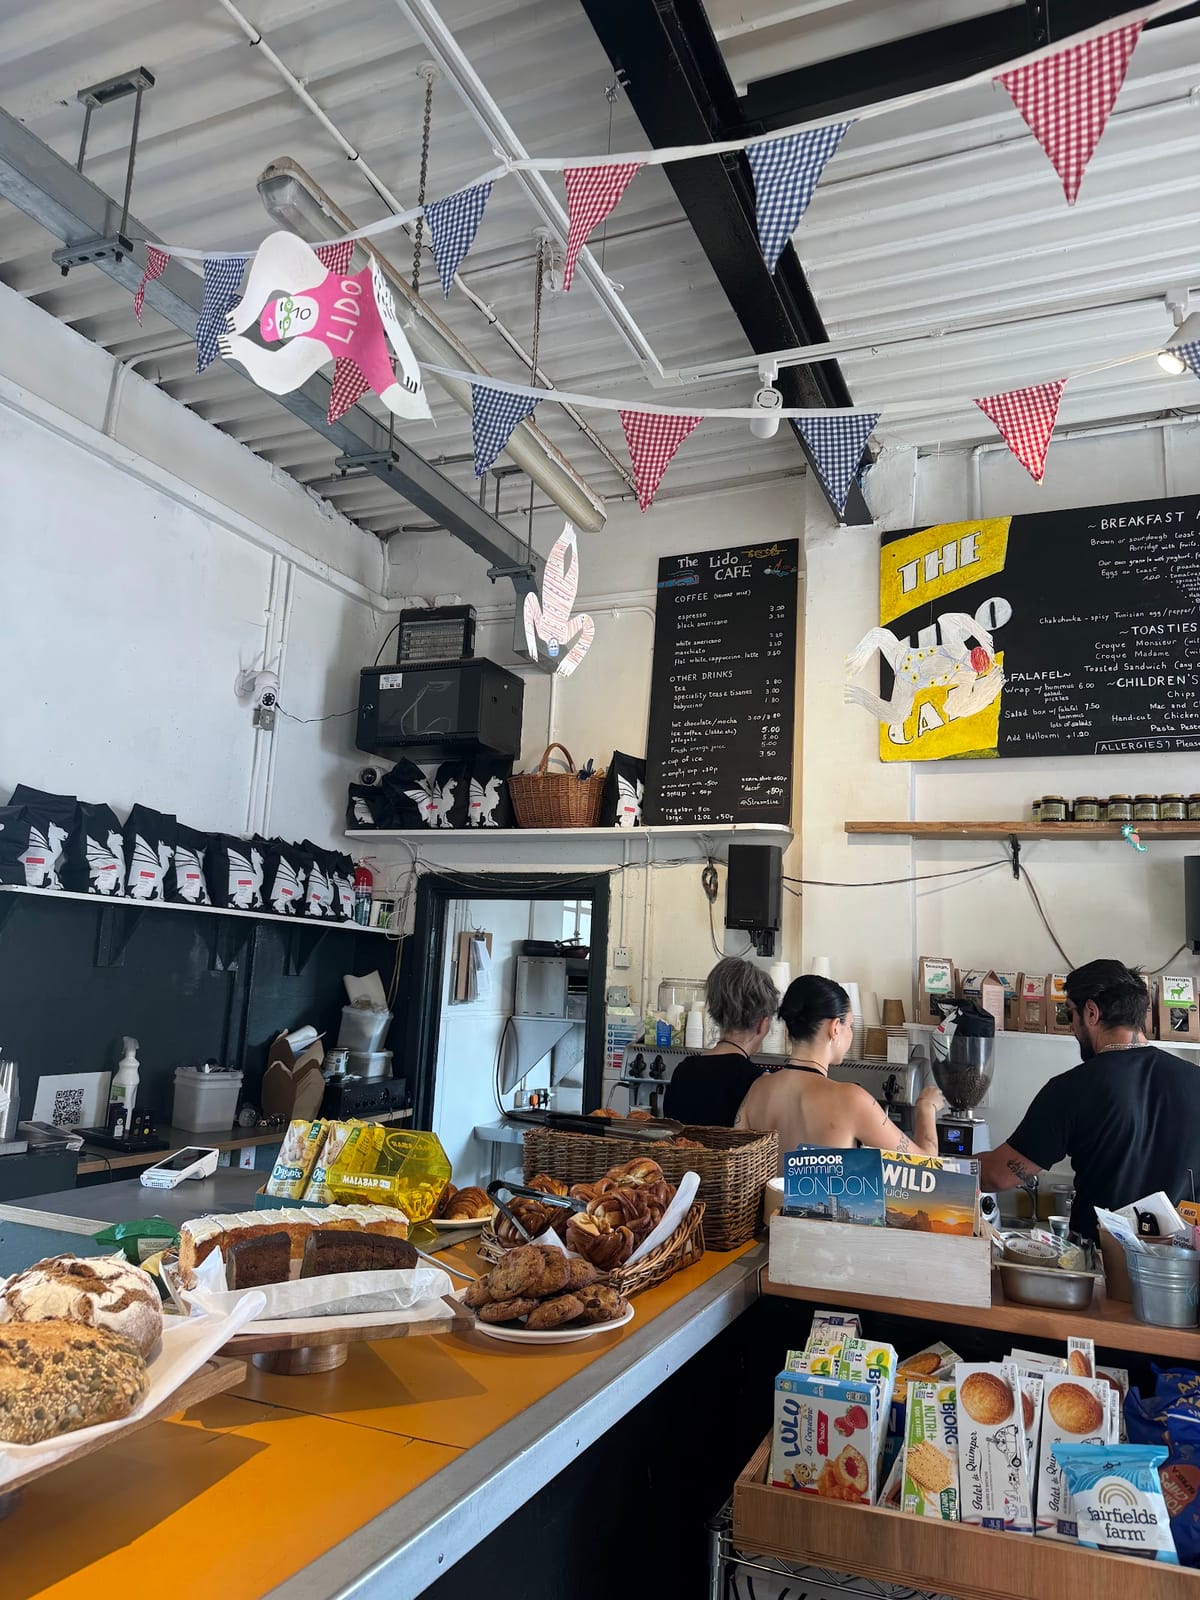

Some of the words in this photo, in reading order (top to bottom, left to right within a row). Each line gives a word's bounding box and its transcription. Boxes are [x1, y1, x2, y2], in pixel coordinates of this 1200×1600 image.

[326, 280, 363, 345] LIDO
[1101, 511, 1184, 530] BREAKFAST
[677, 557, 699, 569] The
[709, 552, 739, 568] Lido
[897, 530, 982, 594] THE
[1101, 568, 1118, 579] Eggs
[674, 592, 709, 603] COFFEE
[677, 612, 707, 621] espresso
[676, 620, 694, 629] black
[697, 619, 728, 628] americano
[1131, 622, 1198, 635] TOASTIES
[675, 639, 692, 647] white
[1095, 642, 1126, 652] Croque
[1135, 639, 1177, 647] Monsieur
[1095, 652, 1127, 662] Croque
[1084, 662, 1119, 672] Toasted
[1124, 661, 1167, 670] Sandwich
[669, 673, 697, 683] OTHER
[702, 670, 733, 681] DRINKS
[1011, 670, 1064, 682] FALAFEL
[1116, 673, 1199, 688] CHILDREN'S
[1004, 687, 1030, 696] Wrap
[1078, 682, 1095, 690] 6.00
[1167, 690, 1195, 699] Chips
[674, 692, 707, 701] speciality
[1004, 709, 1029, 718] Salad
[1111, 713, 1152, 722] Hand-cut
[1164, 711, 1199, 720] Chicken
[761, 726, 781, 734] 5.00
[1150, 724, 1176, 732] Pasta
[1006, 734, 1021, 742] Add
[1025, 731, 1060, 740] Halloumi
[1101, 740, 1171, 751] ALLERGIES?
[681, 755, 690, 763] of
[665, 814, 683, 822] large
[788, 1155, 843, 1167] OUTDOOR
[788, 1163, 844, 1177] swimming
[342, 1175, 379, 1187] MALABAR
[882, 1163, 936, 1193] WILD
[787, 1176, 880, 1197] LONDON
[884, 1188, 909, 1200] uide
[783, 1398, 801, 1457] LULU
[964, 1430, 979, 1472] Quimper
[1088, 1507, 1158, 1525] fairfields
[1104, 1522, 1143, 1541] farm
